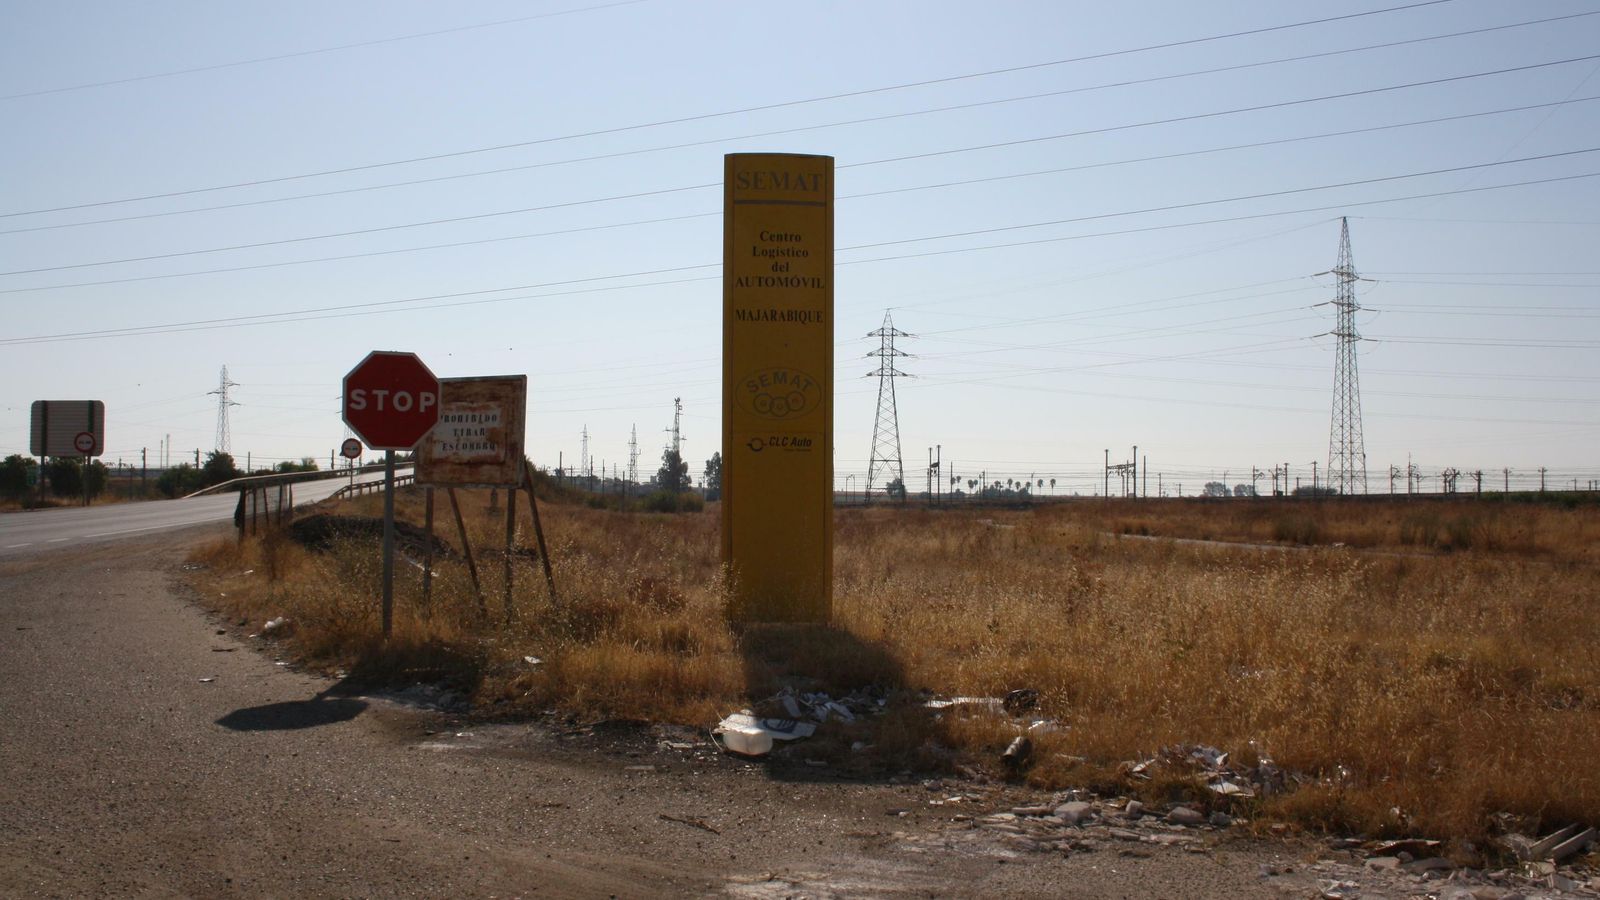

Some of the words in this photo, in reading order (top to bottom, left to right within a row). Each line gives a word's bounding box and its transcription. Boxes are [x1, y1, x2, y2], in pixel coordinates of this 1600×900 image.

[736, 169, 822, 192] SEMAT
[760, 231, 801, 242] Centro
[771, 261, 789, 272] del
[736, 275, 824, 288] AUTOMÓVIL
[736, 309, 823, 324] MAJARABIQUE
[746, 371, 814, 393] SEMAT
[350, 389, 436, 413] STOP
[440, 414, 497, 423] ROHIBIDO
[453, 427, 485, 437] TIRAR
[769, 436, 789, 447] CLC
[790, 437, 812, 447] Auto
